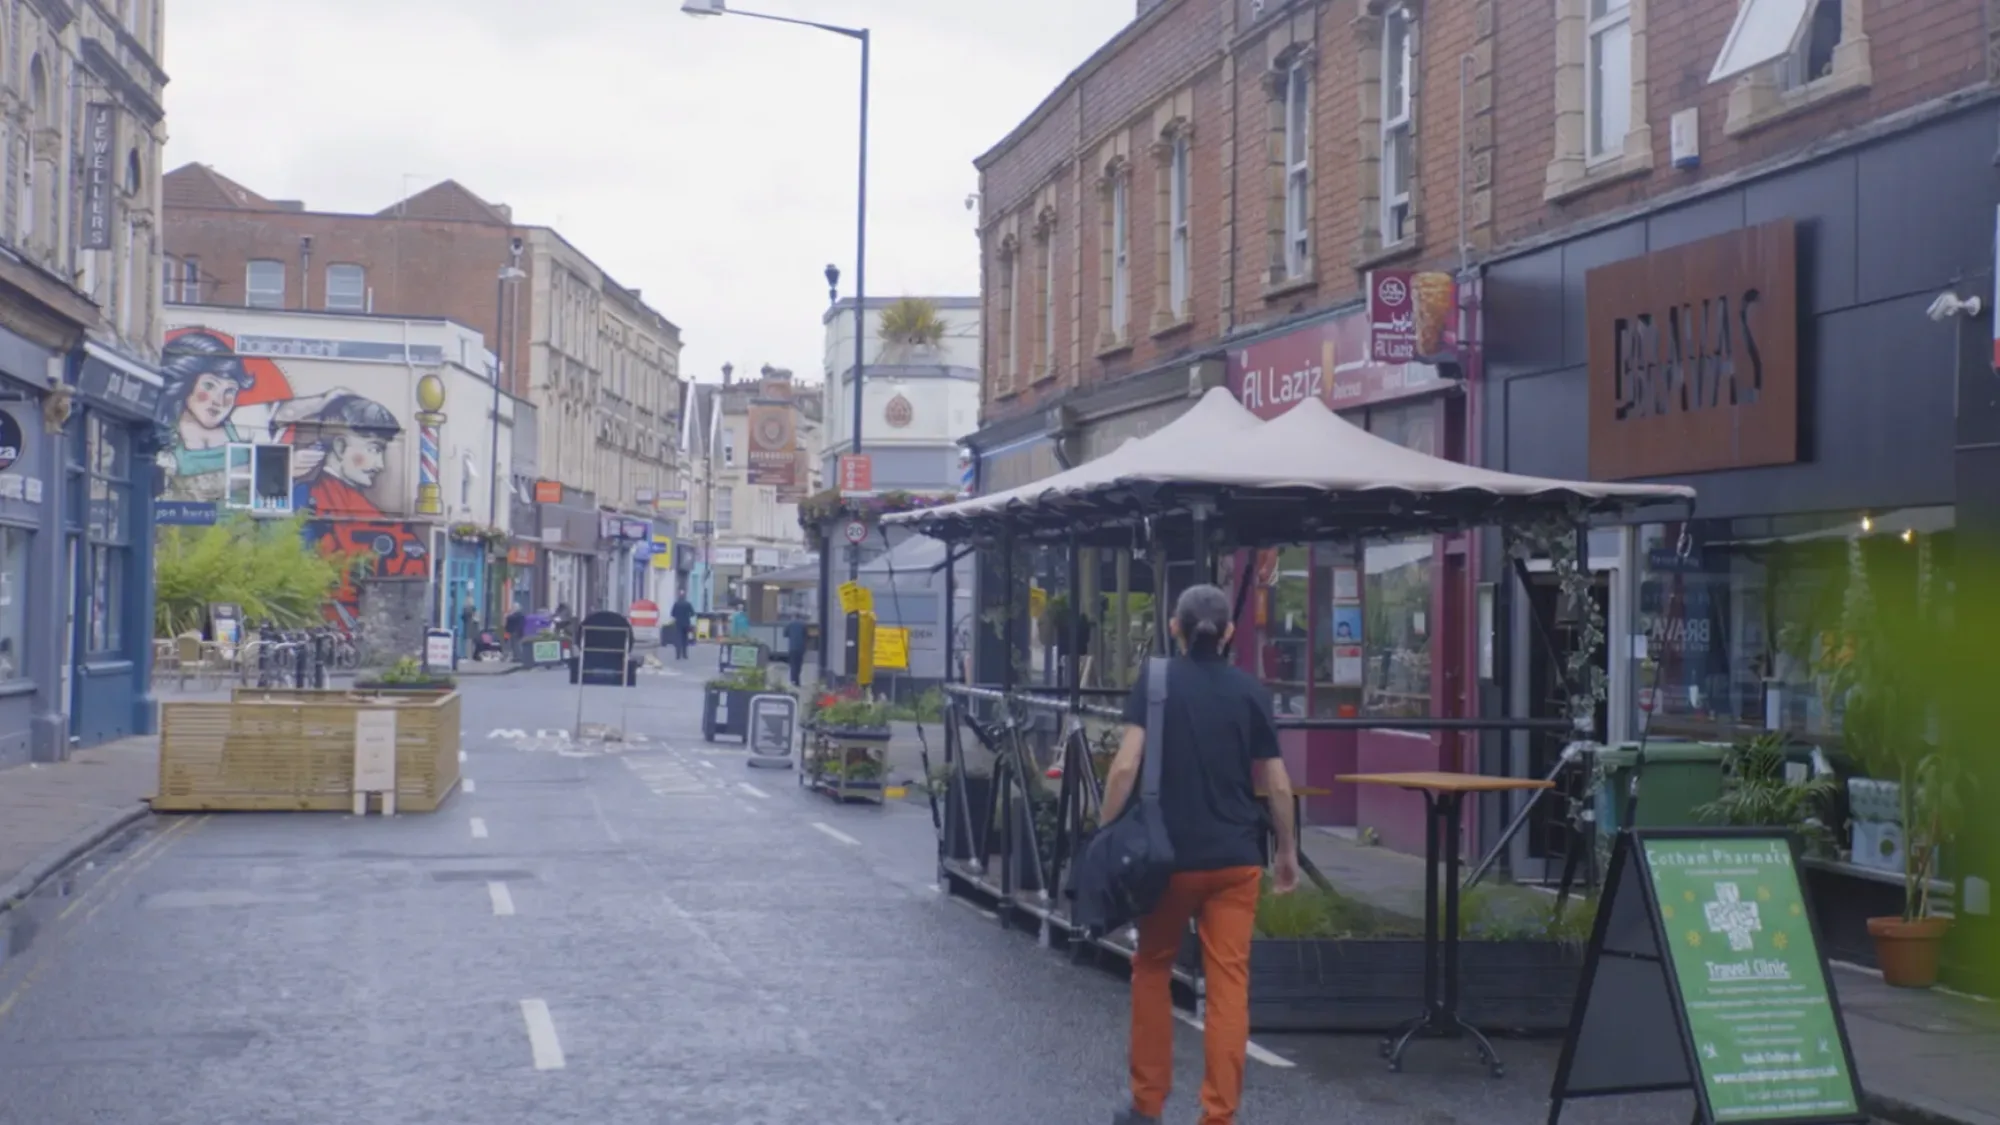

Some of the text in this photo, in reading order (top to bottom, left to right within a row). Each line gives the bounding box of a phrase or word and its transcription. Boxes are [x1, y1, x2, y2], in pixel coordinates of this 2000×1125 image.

[91, 110, 107, 244] JEWELLERS
[1374, 340, 1413, 357] Al Laziz
[1241, 358, 1323, 409] Al Laziz
[848, 526, 863, 537] 20
[1646, 848, 1791, 867] Cotham Pharmacy
[1705, 958, 1790, 979] Travel Clinic
